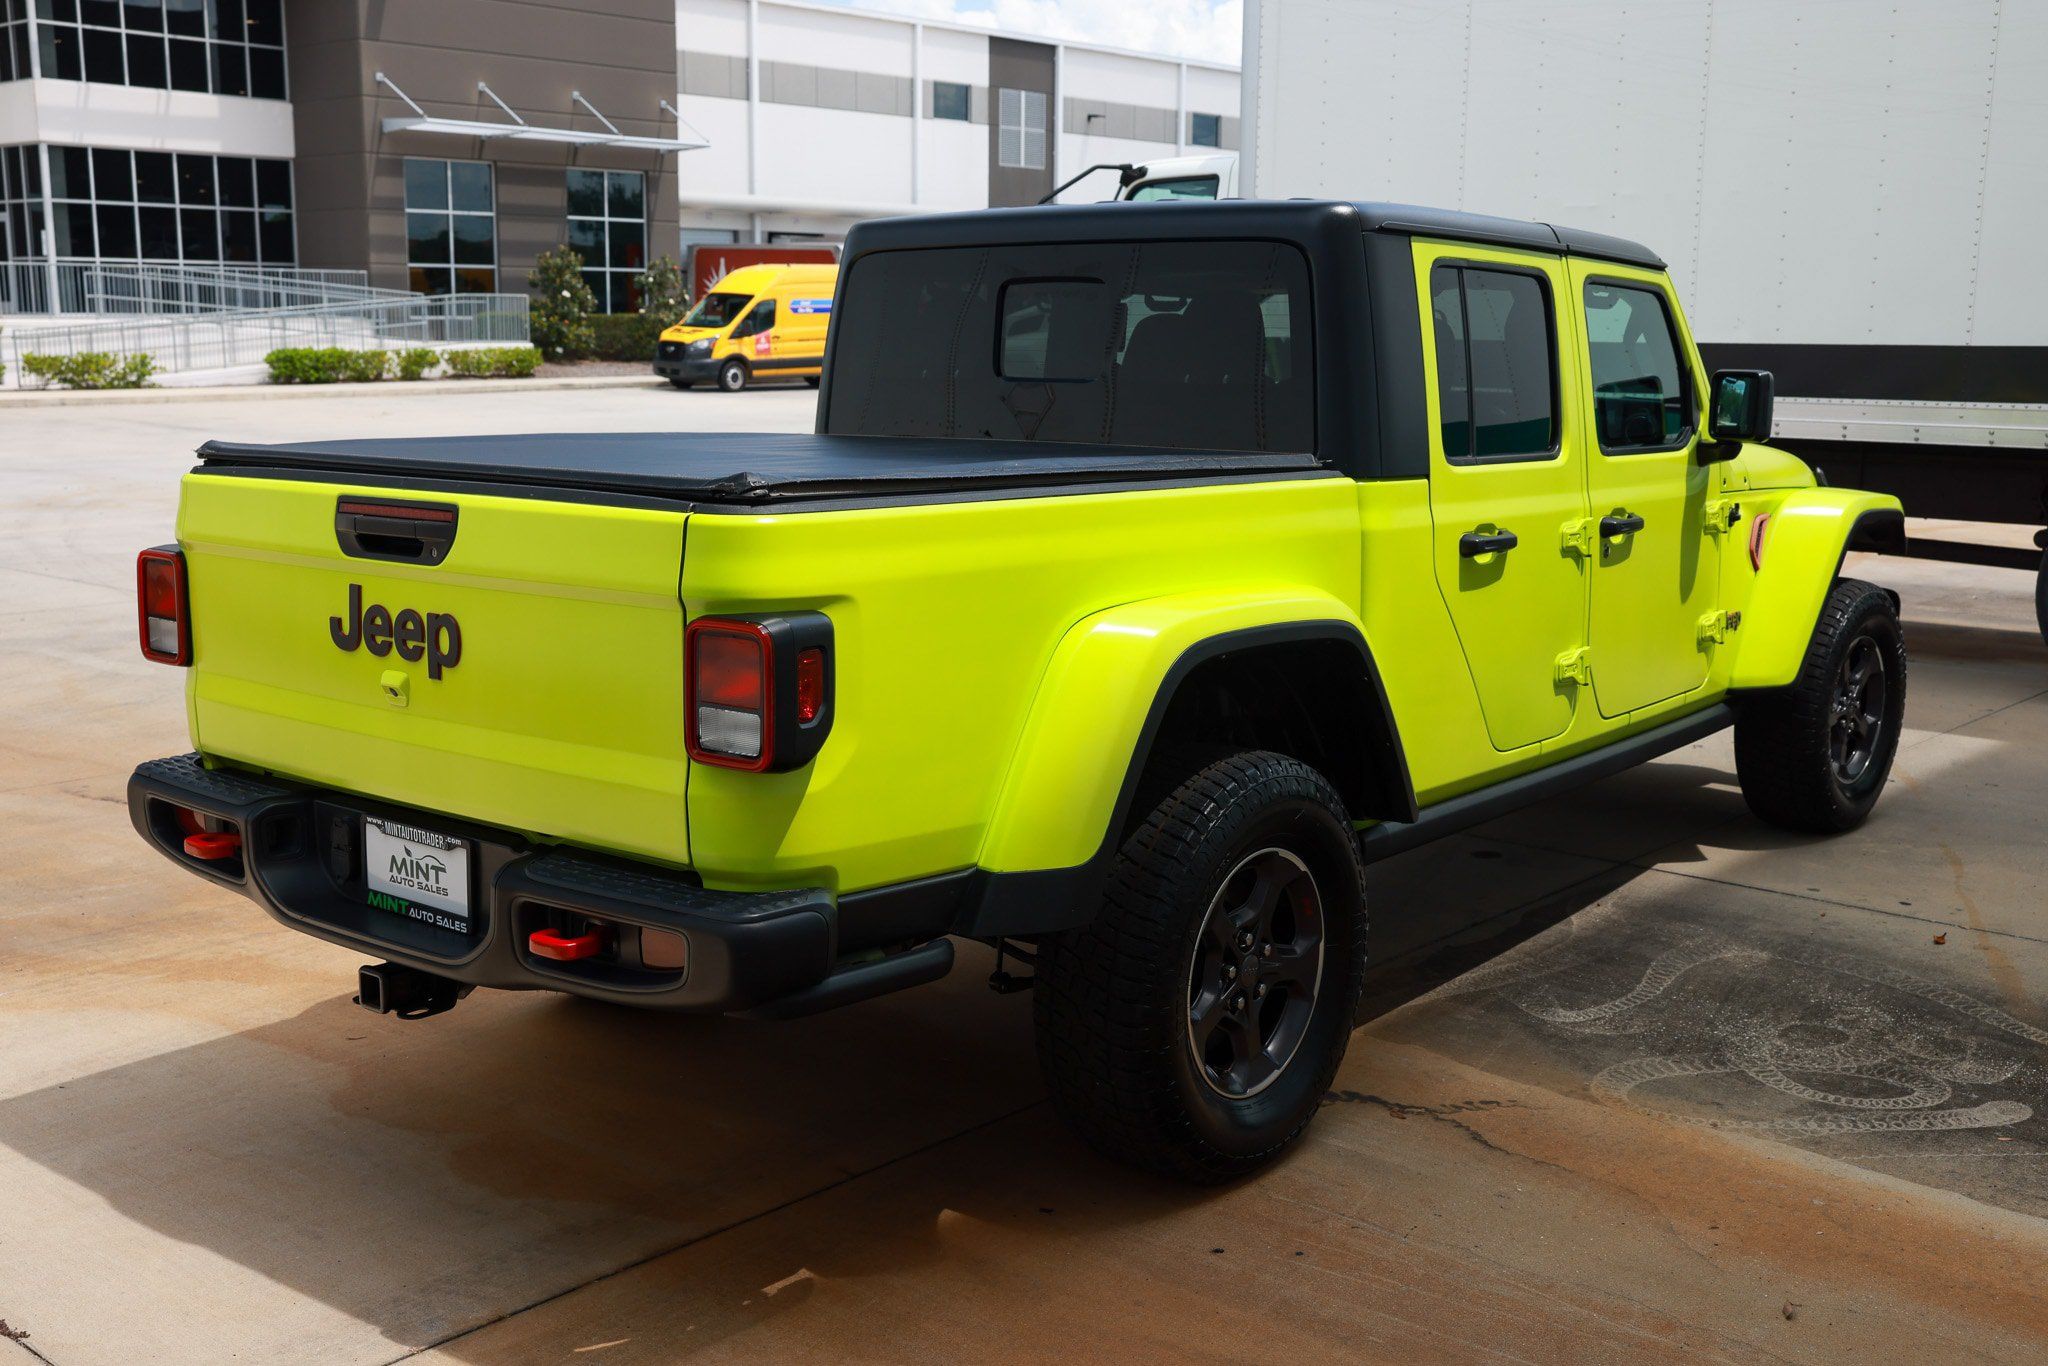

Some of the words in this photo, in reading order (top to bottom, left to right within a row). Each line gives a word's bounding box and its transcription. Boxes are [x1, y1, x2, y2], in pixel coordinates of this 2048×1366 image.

[329, 583, 462, 681] Jeep
[389, 854, 447, 885] MINT
[389, 875, 415, 888] AUTO
[417, 881, 449, 897] SALES
[367, 890, 409, 915] MINT
[409, 907, 434, 923] AUTO
[436, 915, 467, 934] SALES
